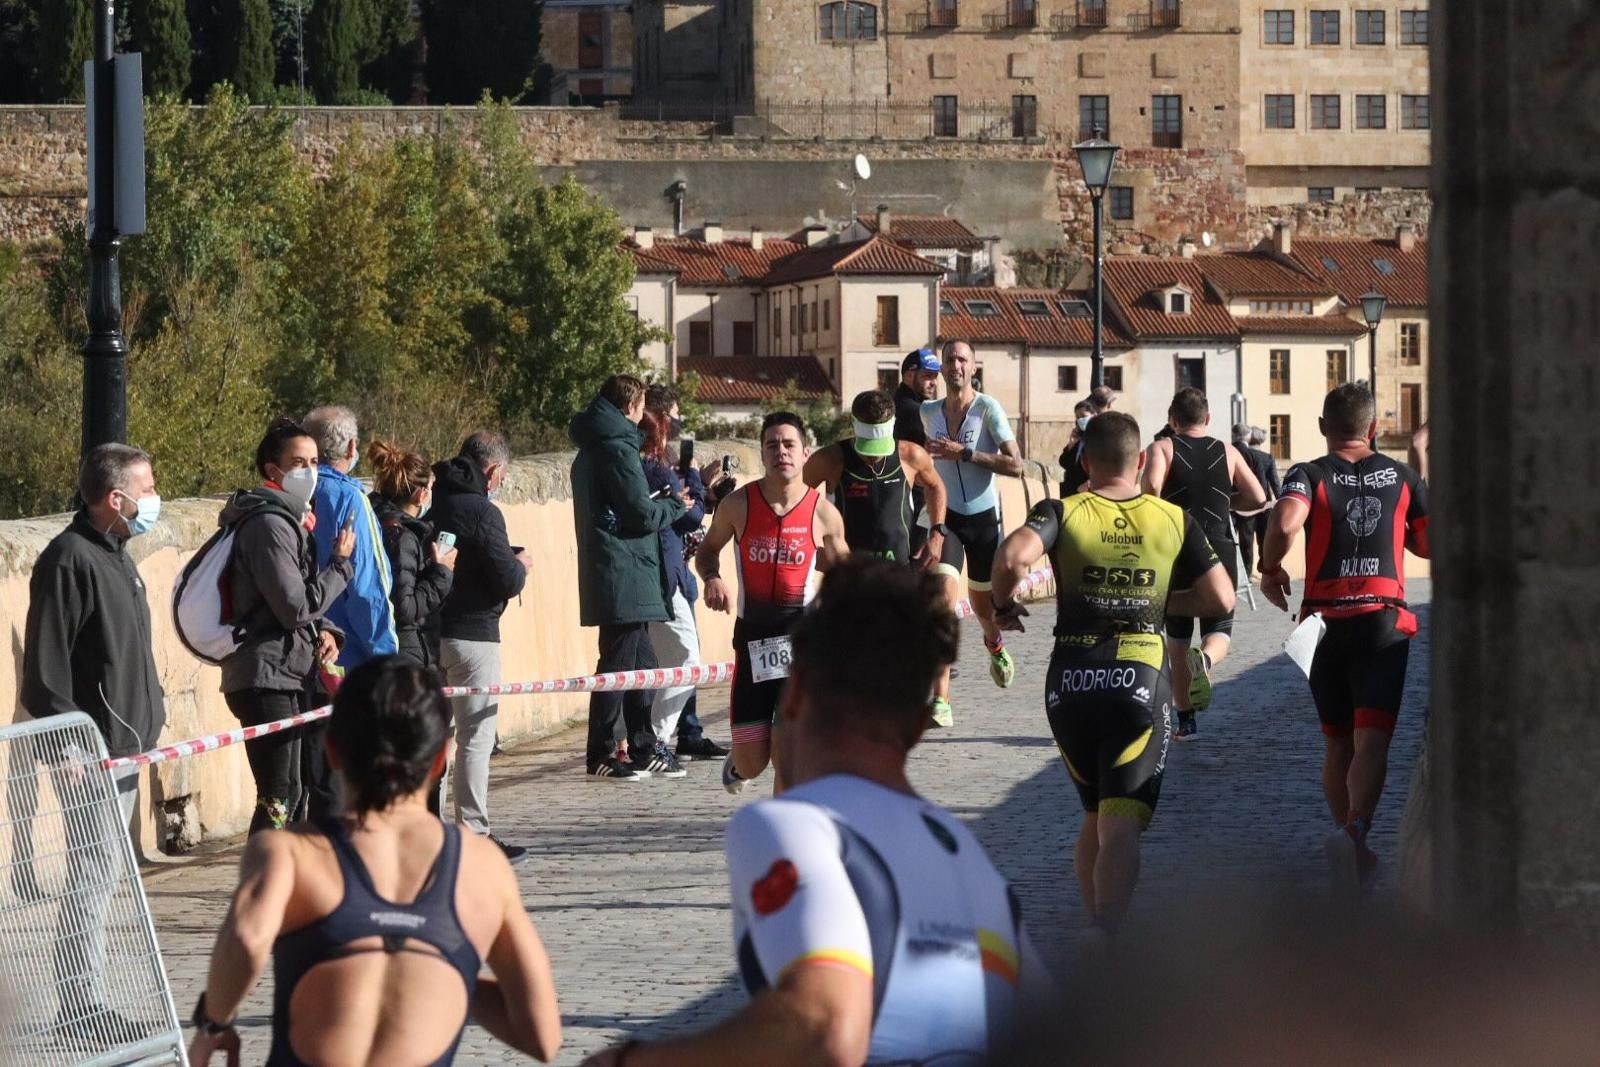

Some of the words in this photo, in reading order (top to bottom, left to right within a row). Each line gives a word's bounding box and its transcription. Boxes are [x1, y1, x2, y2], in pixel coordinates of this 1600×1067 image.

[1100, 531, 1144, 546] Velobur
[749, 547, 805, 565] SOTELO
[759, 650, 790, 669] 108
[1061, 667, 1135, 692] RODRIGO
